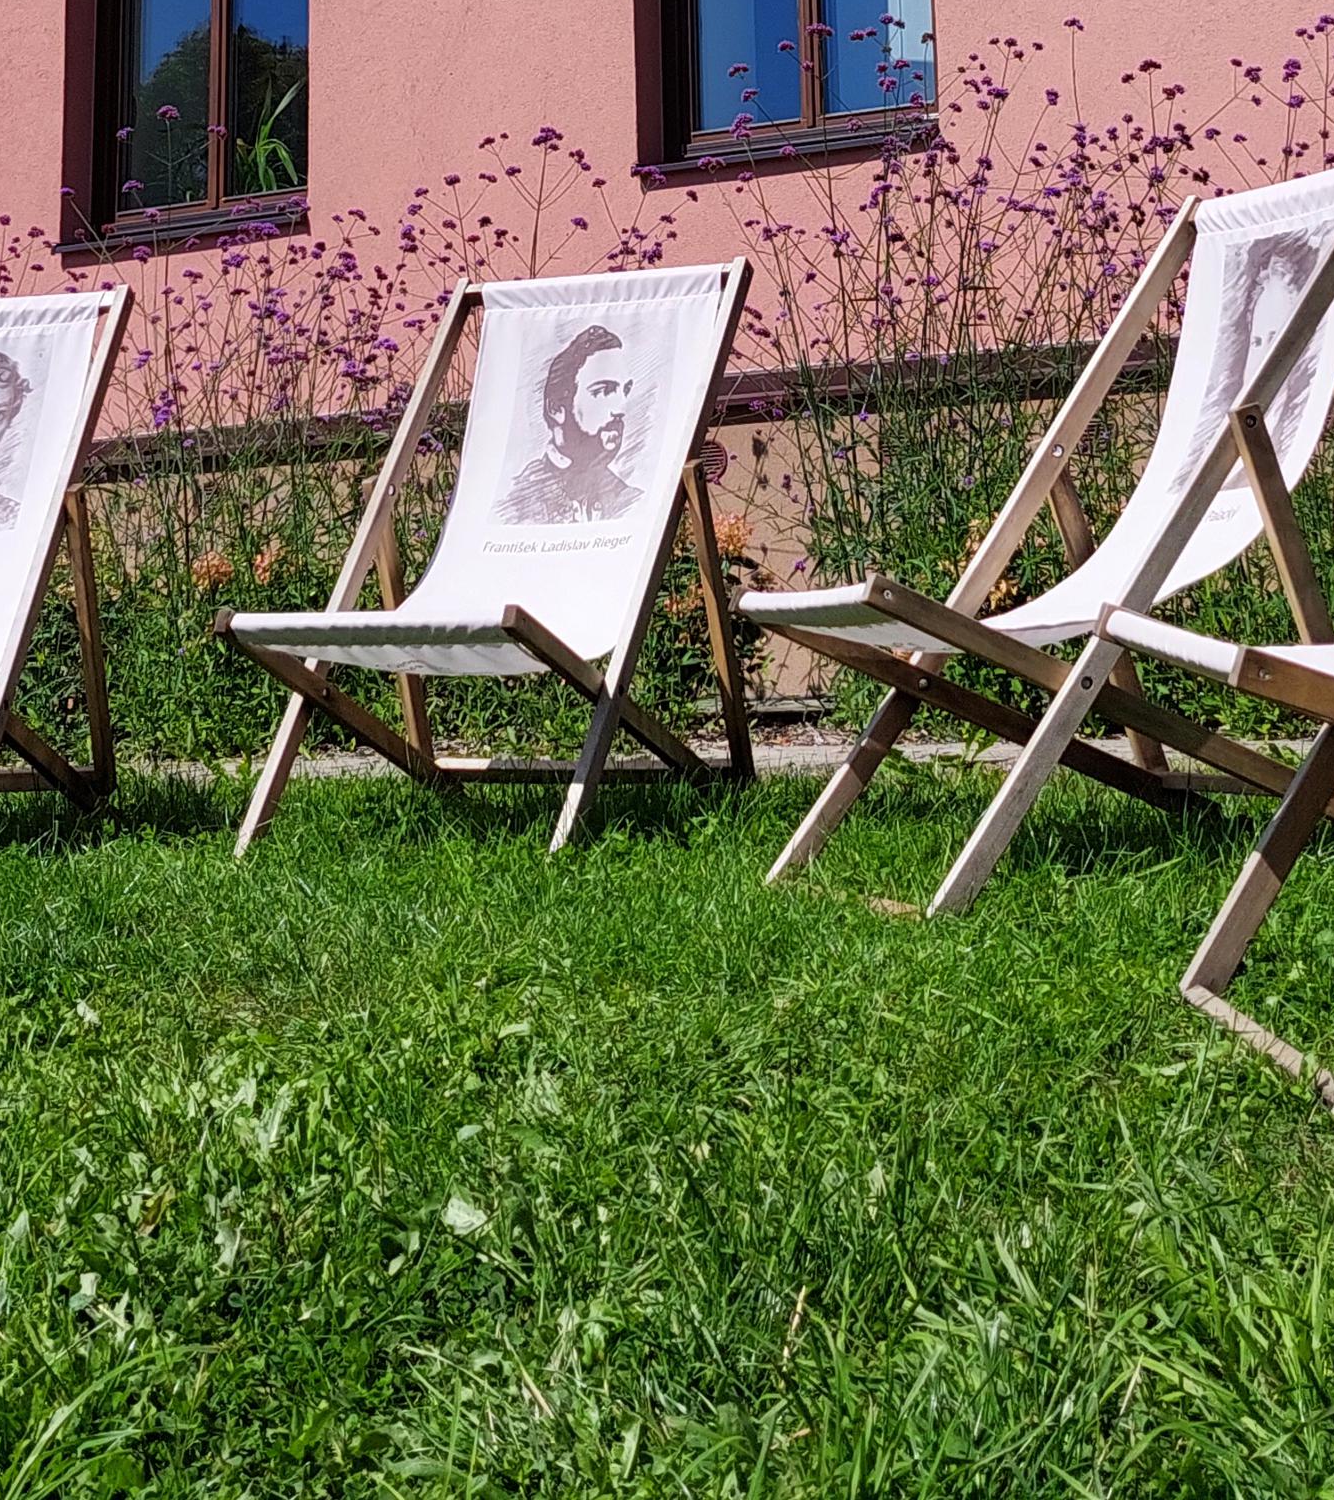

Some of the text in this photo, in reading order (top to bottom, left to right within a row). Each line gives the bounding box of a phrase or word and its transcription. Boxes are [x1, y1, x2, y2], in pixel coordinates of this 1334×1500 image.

[482, 533, 632, 554] František Ladislav Rieger
